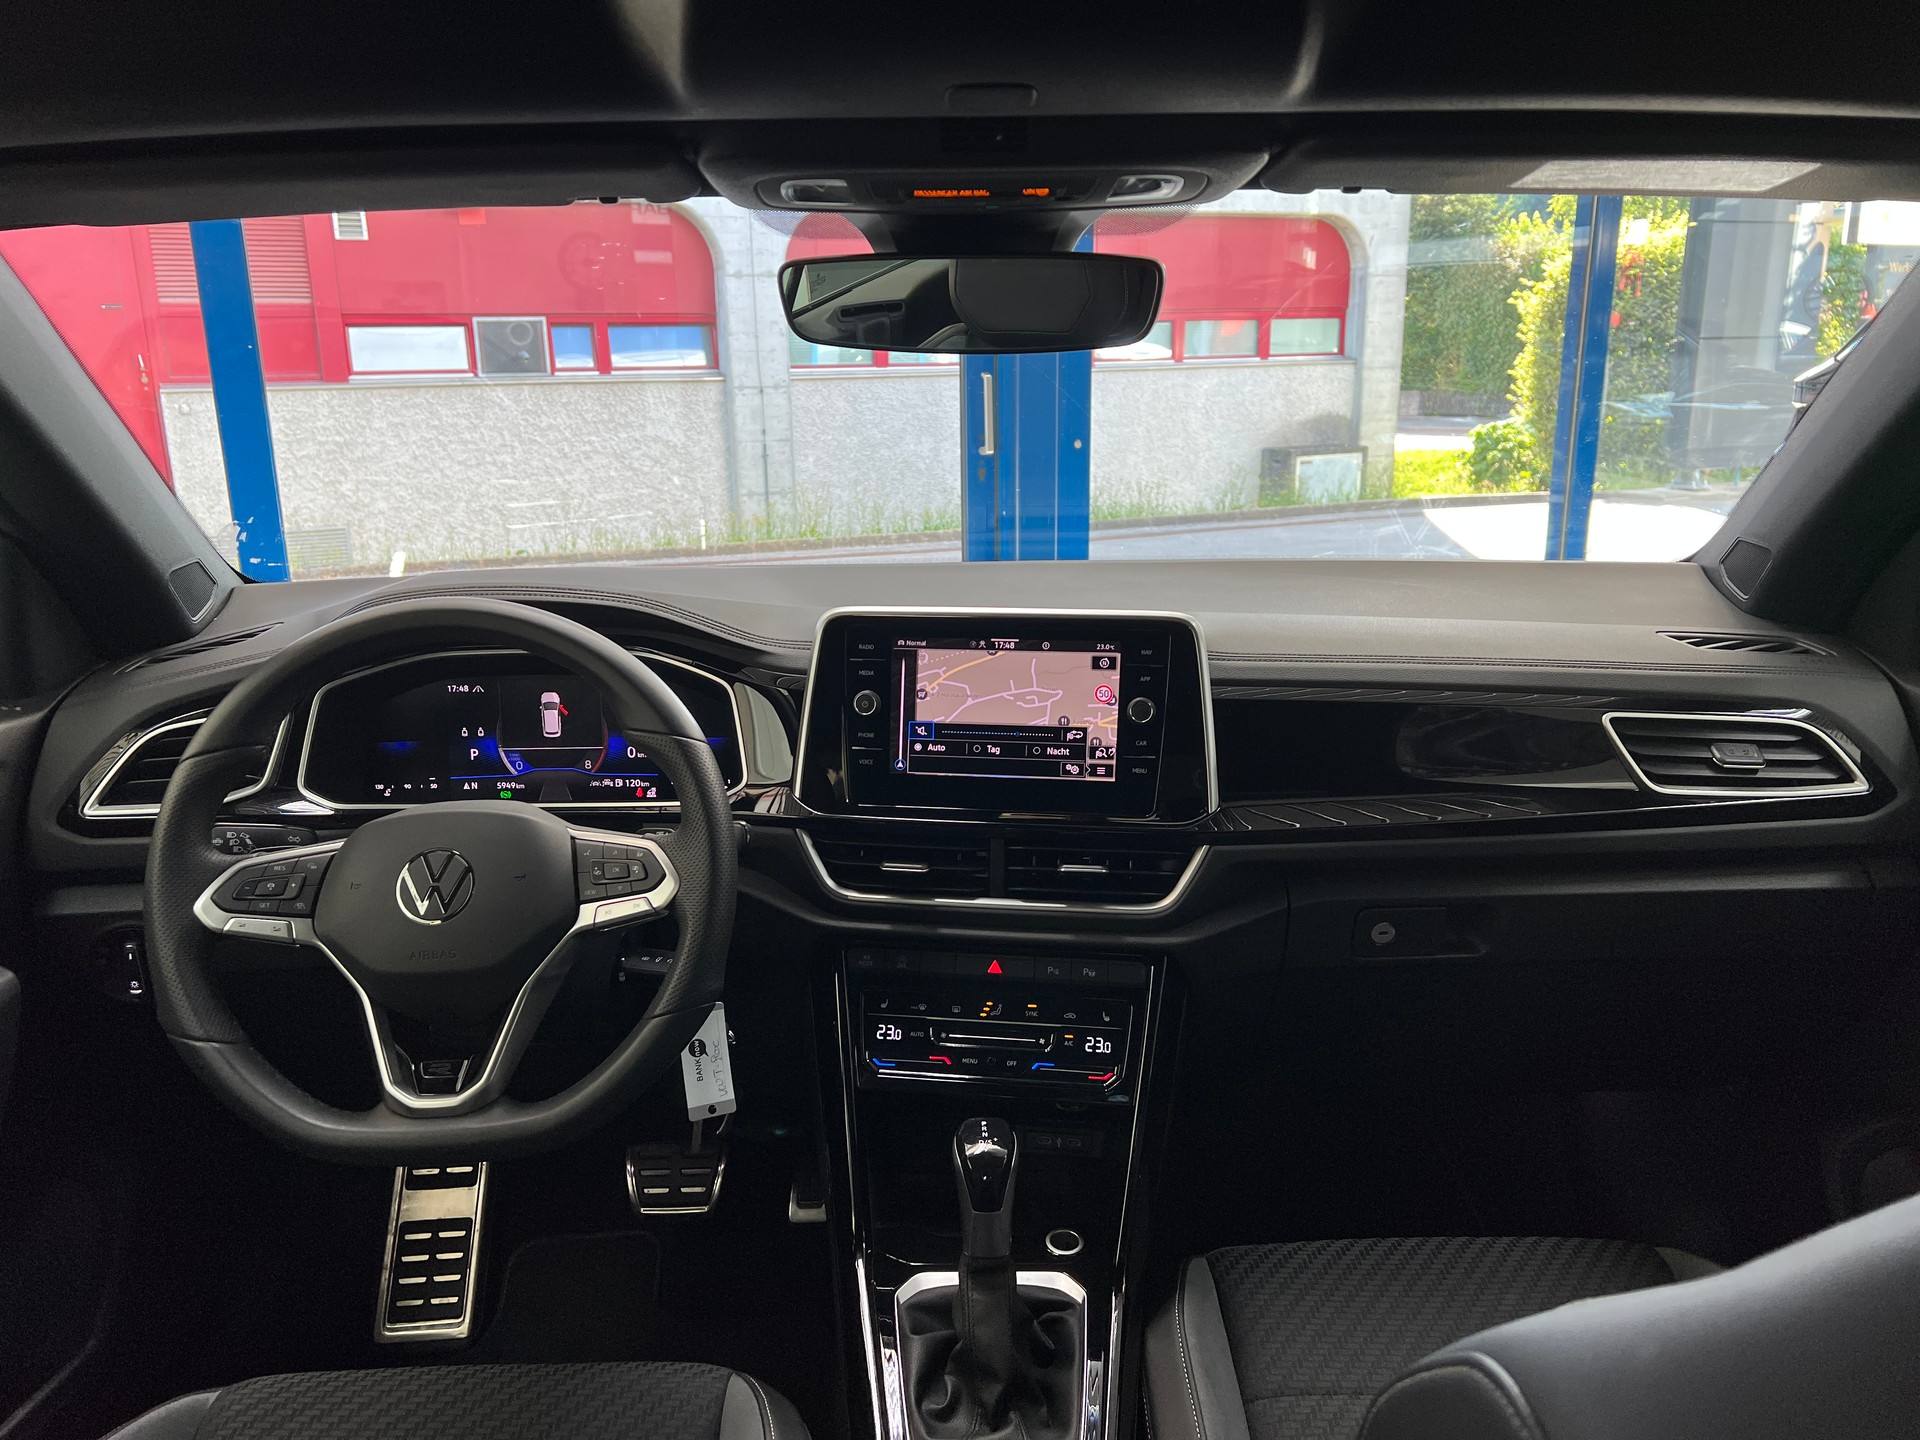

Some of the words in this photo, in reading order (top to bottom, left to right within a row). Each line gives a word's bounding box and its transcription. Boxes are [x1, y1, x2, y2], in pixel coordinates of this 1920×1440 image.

[994, 641, 1015, 650] 17:48
[447, 684, 469, 693] 17:48
[1098, 689, 1110, 698] 50
[627, 746, 636, 759] 0
[927, 743, 946, 752] Auto
[986, 744, 1001, 755] Tag
[1046, 746, 1070, 756] Nacht
[470, 748, 479, 761] P
[515, 761, 523, 770] 0
[584, 759, 592, 769] 8
[409, 949, 457, 961] AIRBAG
[876, 1024, 902, 1041] 23.0
[1084, 1036, 1112, 1054] 23.0
[961, 1057, 979, 1065] MENU
[694, 1058, 704, 1082] BANK
